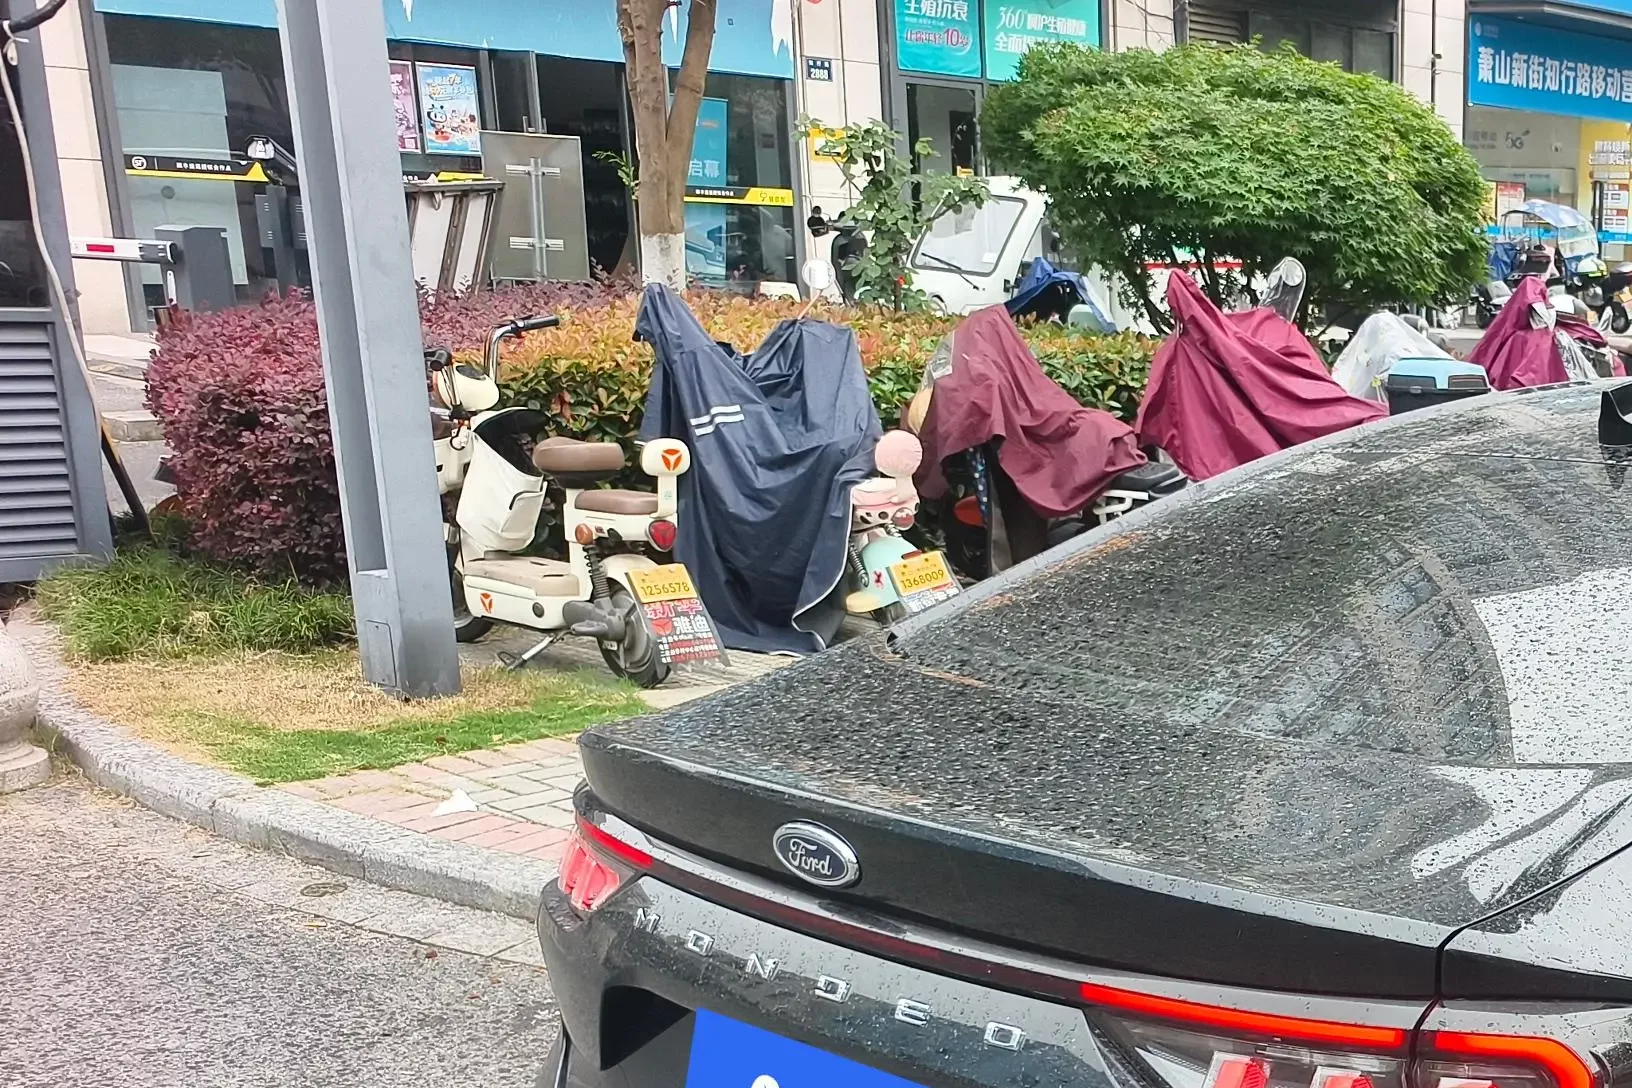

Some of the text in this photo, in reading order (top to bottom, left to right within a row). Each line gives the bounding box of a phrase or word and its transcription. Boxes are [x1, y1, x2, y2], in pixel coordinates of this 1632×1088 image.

[640, 581, 690, 597] 1256578
[900, 569, 945, 589] 1368009
[671, 614, 711, 634] 雅迪
[787, 836, 834, 877] Ford
[633, 907, 1027, 1052] MONDEO
